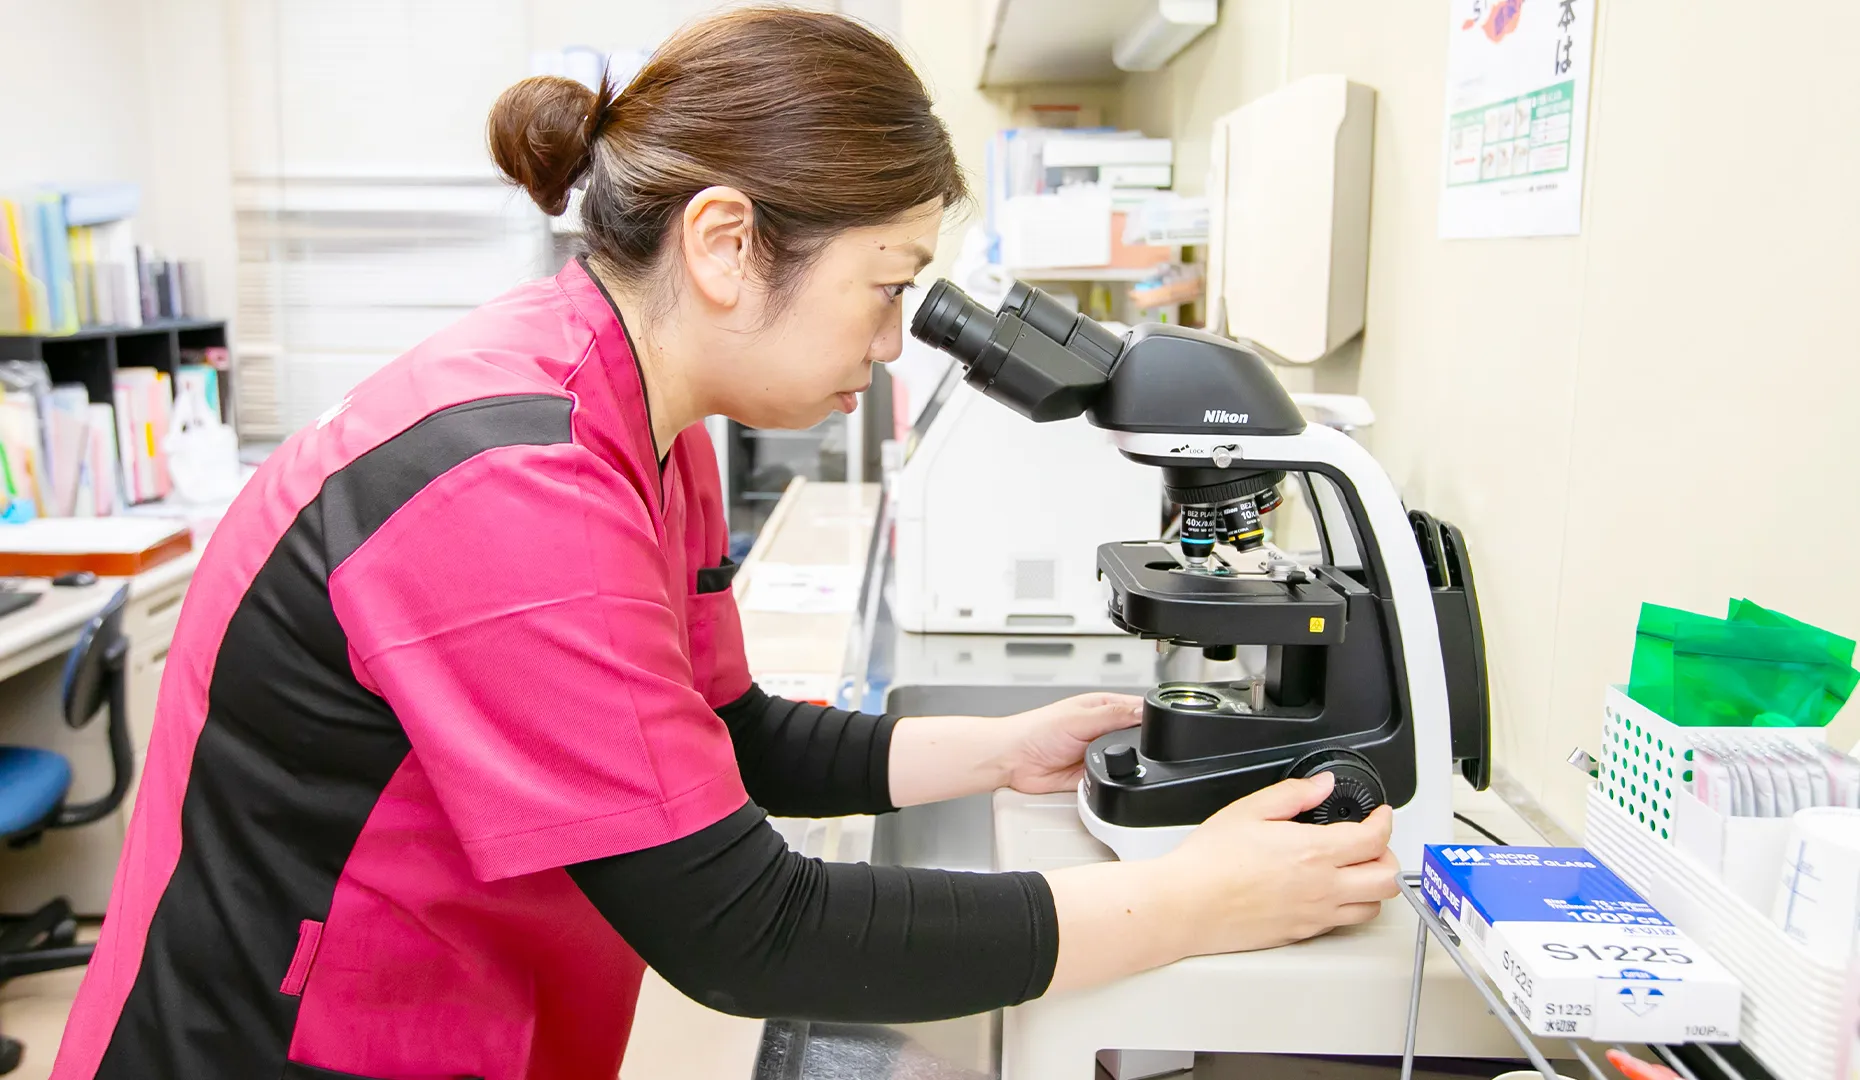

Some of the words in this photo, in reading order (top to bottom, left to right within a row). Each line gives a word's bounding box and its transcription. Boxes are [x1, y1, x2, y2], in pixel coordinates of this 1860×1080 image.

[1203, 410, 1249, 424] Nikon
[1187, 510, 1199, 518] BE2
[1495, 859, 1543, 867] SLIDE
[1543, 860, 1597, 869] GLASS
[1423, 877, 1441, 906] GLASS
[1424, 862, 1443, 891] MICRO
[1442, 882, 1461, 912] SLIDE
[1542, 943, 1693, 964] S1225
[1502, 949, 1533, 998] S1225
[1545, 1002, 1593, 1016] S1225
